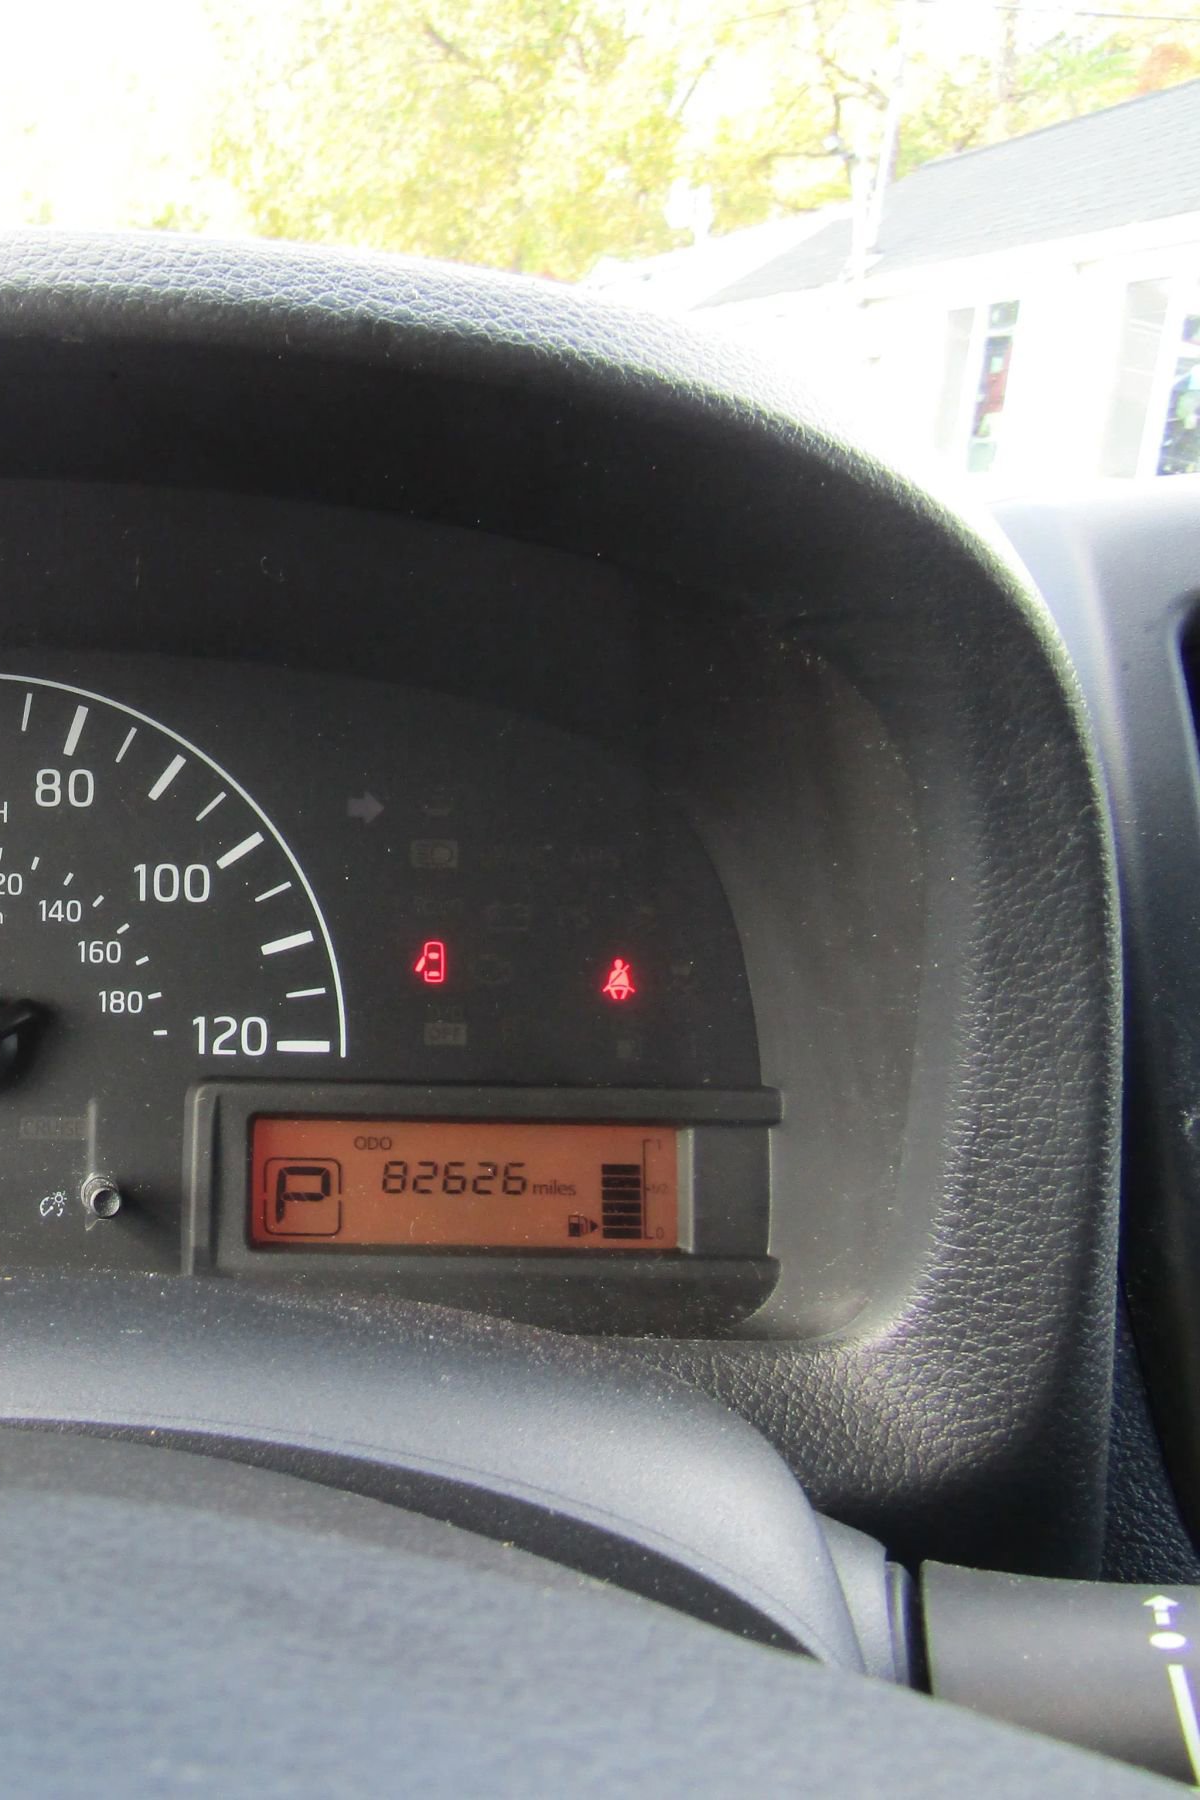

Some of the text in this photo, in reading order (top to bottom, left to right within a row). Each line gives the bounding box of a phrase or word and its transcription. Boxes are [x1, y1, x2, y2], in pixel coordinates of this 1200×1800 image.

[34, 769, 95, 808] 80
[133, 863, 211, 903] 100
[38, 900, 82, 922] 140
[77, 941, 122, 964] 160
[99, 991, 143, 1014] 180
[192, 1016, 268, 1056] 120
[22, 1119, 86, 1138] CRUISE
[353, 1136, 393, 1151] ODO
[382, 1160, 577, 1196] 82626 miles
[274, 1166, 332, 1225] P
[655, 1226, 665, 1240] 0
